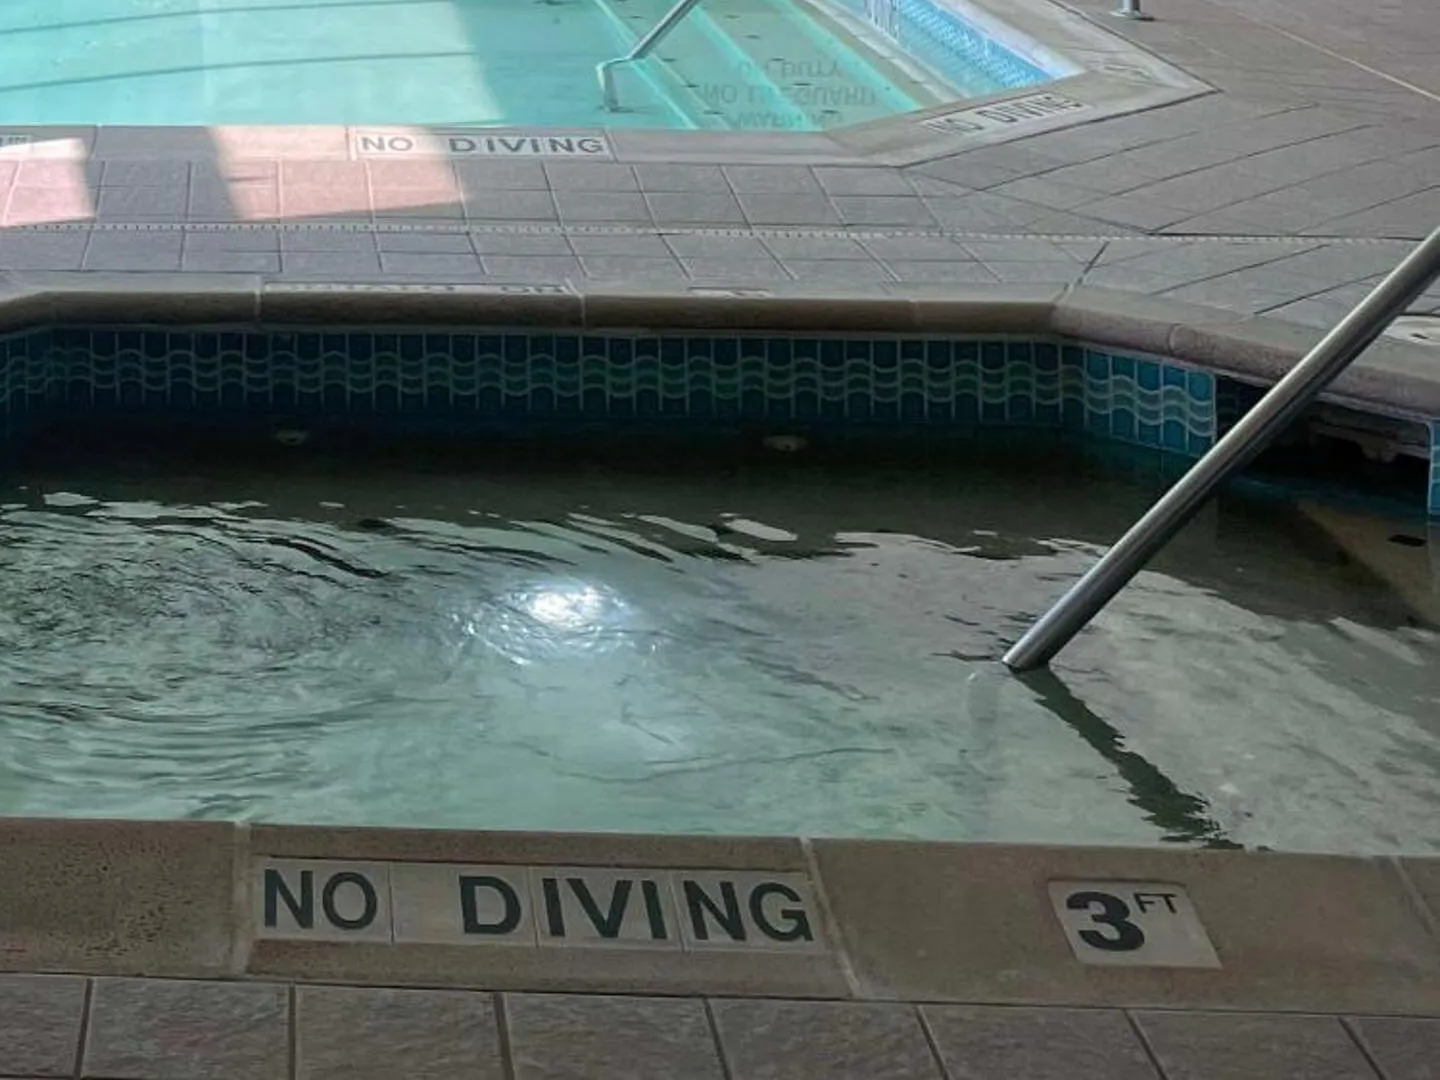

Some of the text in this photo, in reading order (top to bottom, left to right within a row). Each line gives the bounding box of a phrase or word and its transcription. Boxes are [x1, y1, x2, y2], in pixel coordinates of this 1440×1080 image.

[361, 136, 603, 153] NO DIVING
[262, 868, 816, 944] NO DIVING
